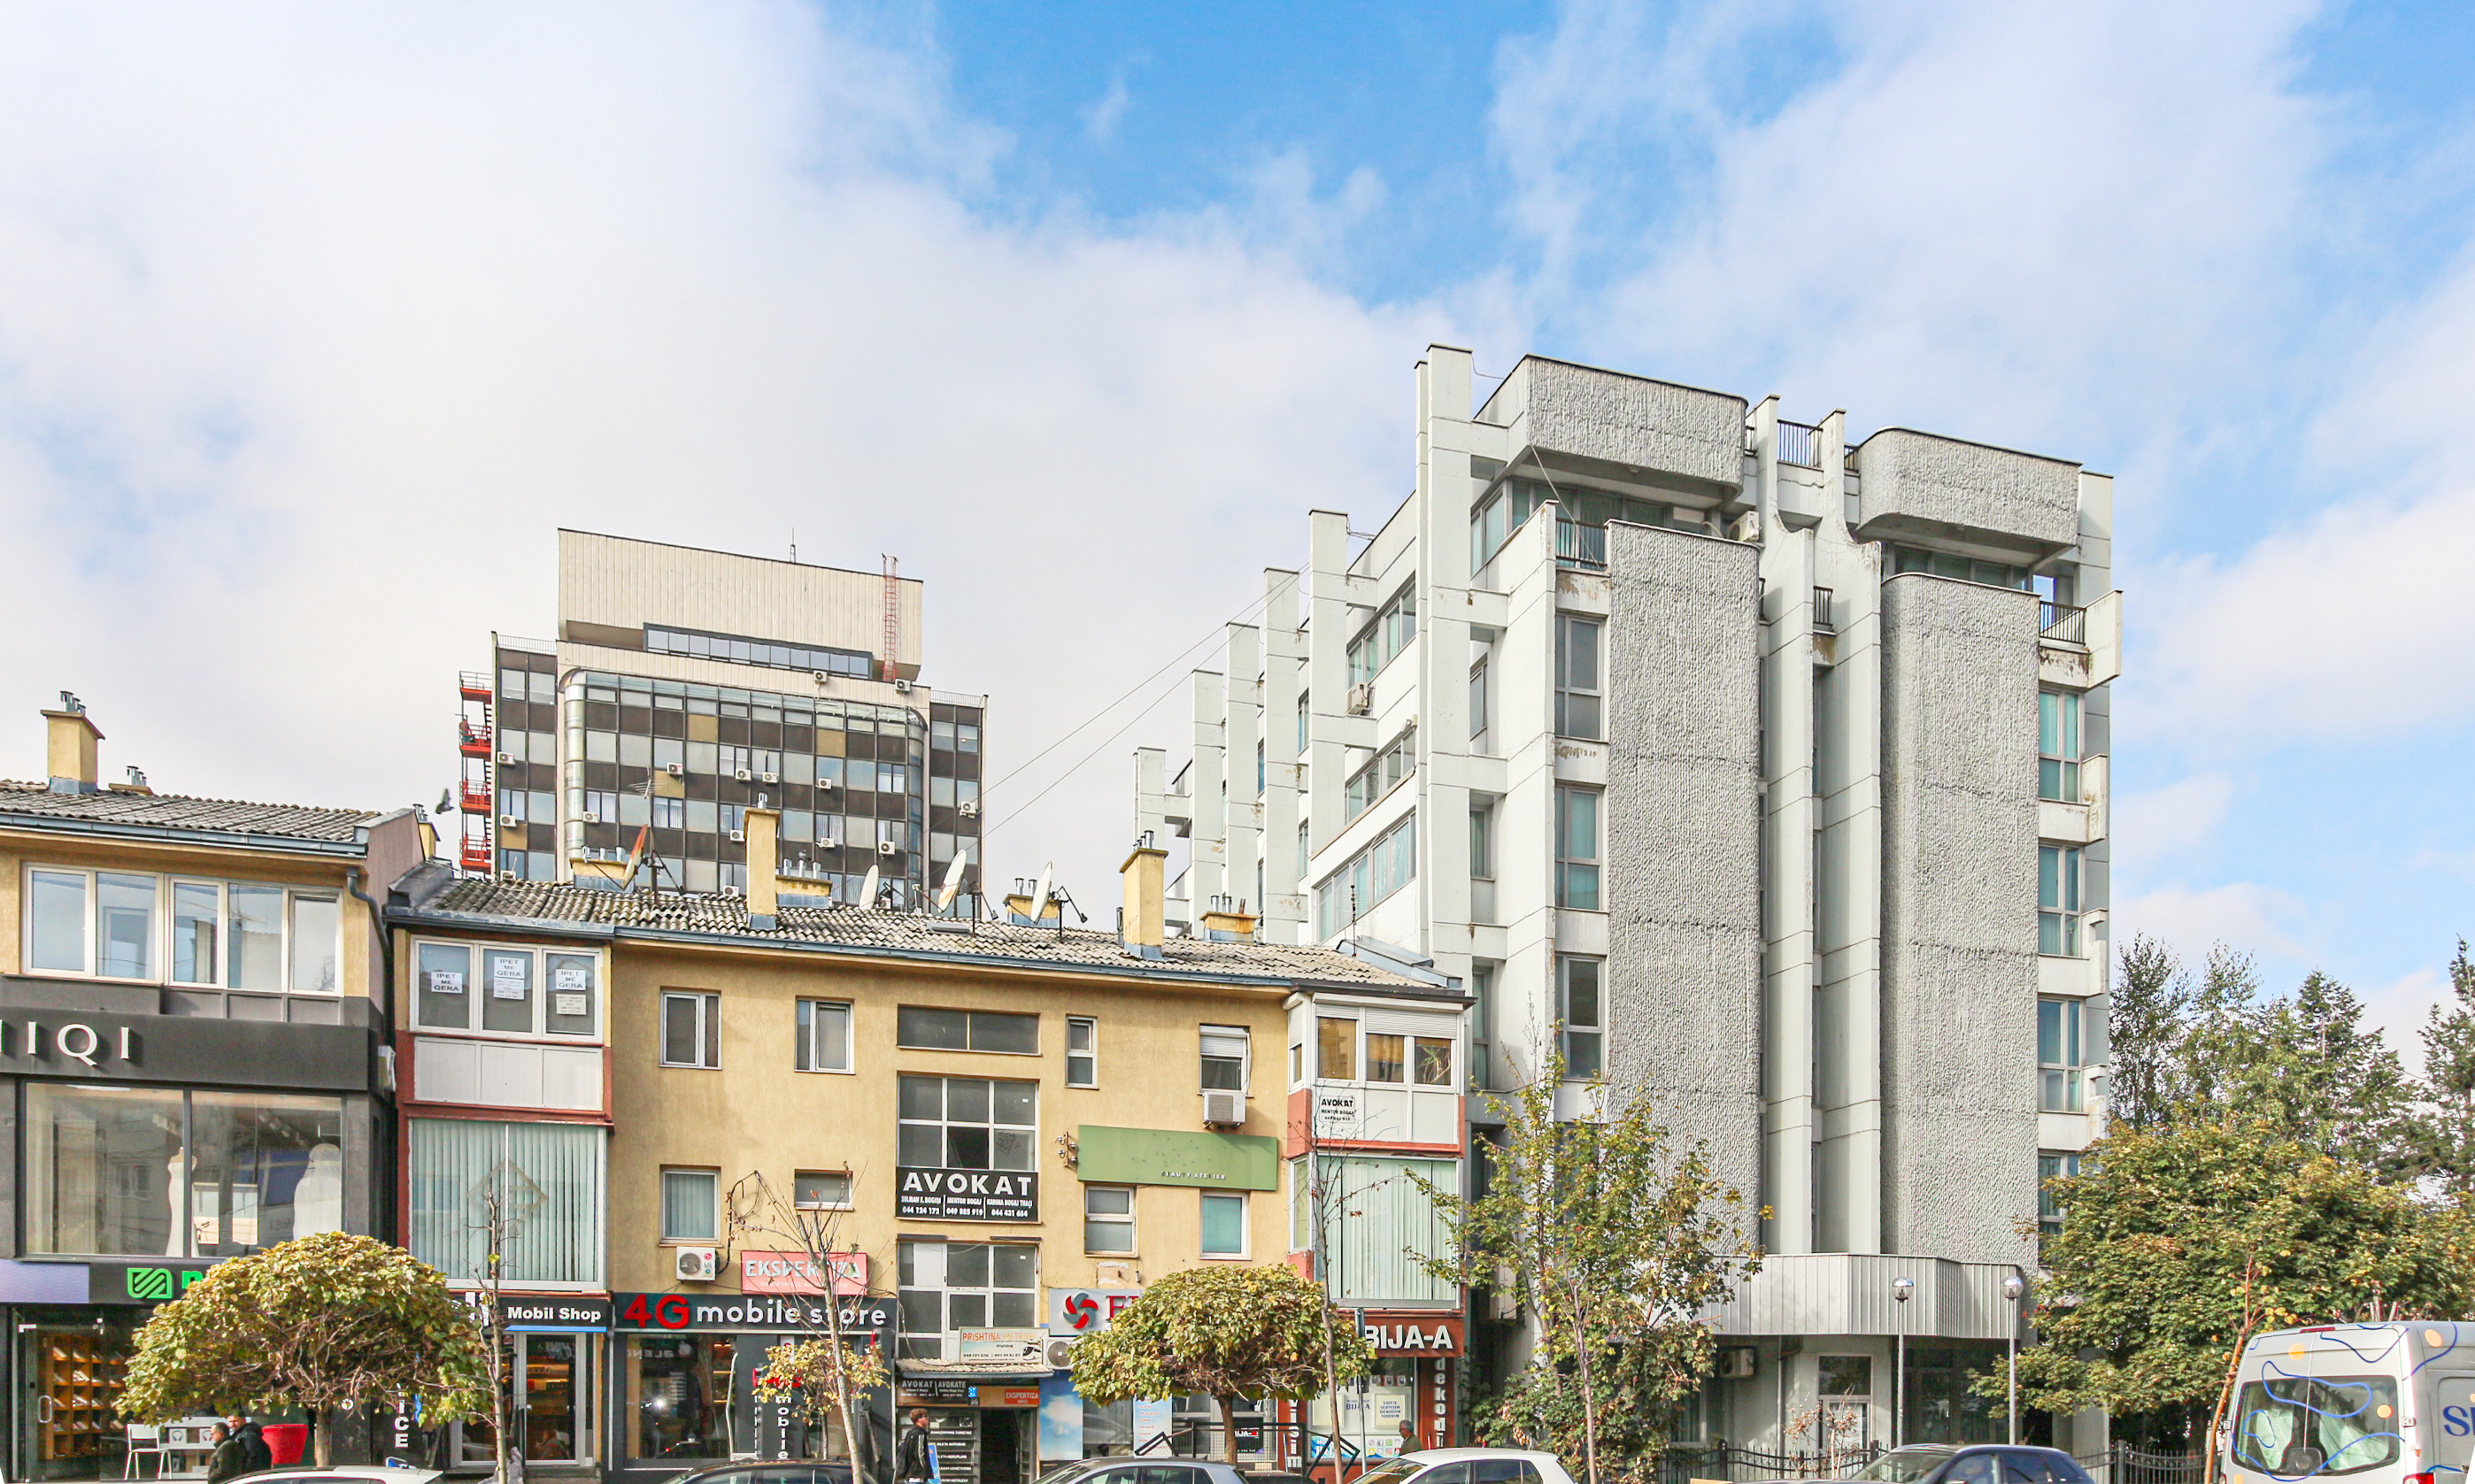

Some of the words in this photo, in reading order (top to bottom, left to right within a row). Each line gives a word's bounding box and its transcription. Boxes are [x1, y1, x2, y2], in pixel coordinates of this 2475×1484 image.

[0, 1019, 130, 1067] IQI
[1322, 1098, 1353, 1107] AVOKAT
[903, 1172, 1032, 1196] AVOKAT
[745, 1260, 862, 1278] EKSPERIZA
[507, 1306, 554, 1319] Mobil
[559, 1307, 602, 1323] Shop
[623, 1293, 690, 1329] 4G
[697, 1299, 800, 1324] mobile
[810, 1306, 887, 1326] sore
[962, 1333, 1001, 1342] PRISHTINA
[1365, 1325, 1453, 1349] BIJA-A
[775, 1396, 792, 1459] mobile
